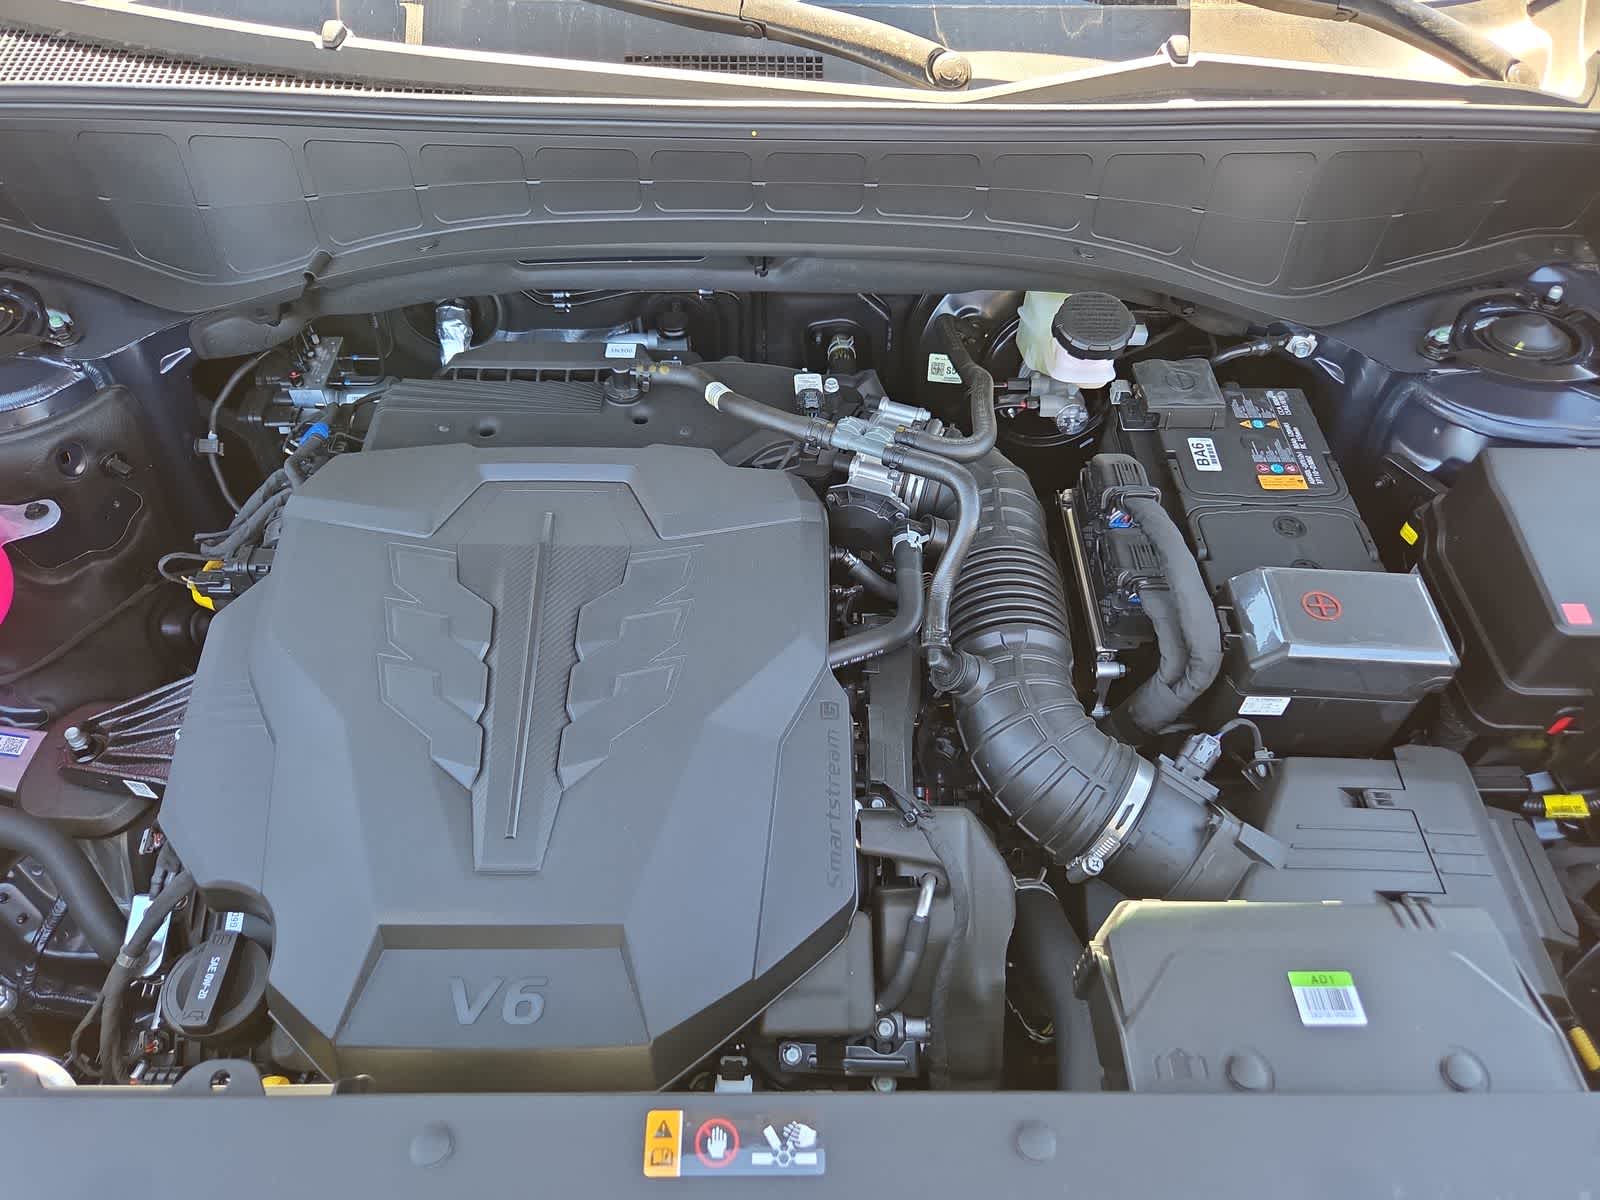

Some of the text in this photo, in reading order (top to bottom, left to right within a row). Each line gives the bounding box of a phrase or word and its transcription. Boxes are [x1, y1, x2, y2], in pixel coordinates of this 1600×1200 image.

[1191, 443, 1211, 466] BA6
[825, 728, 842, 888] Smartstream
[198, 956, 220, 1000] SAE 0W-20
[448, 976, 551, 1025] V6
